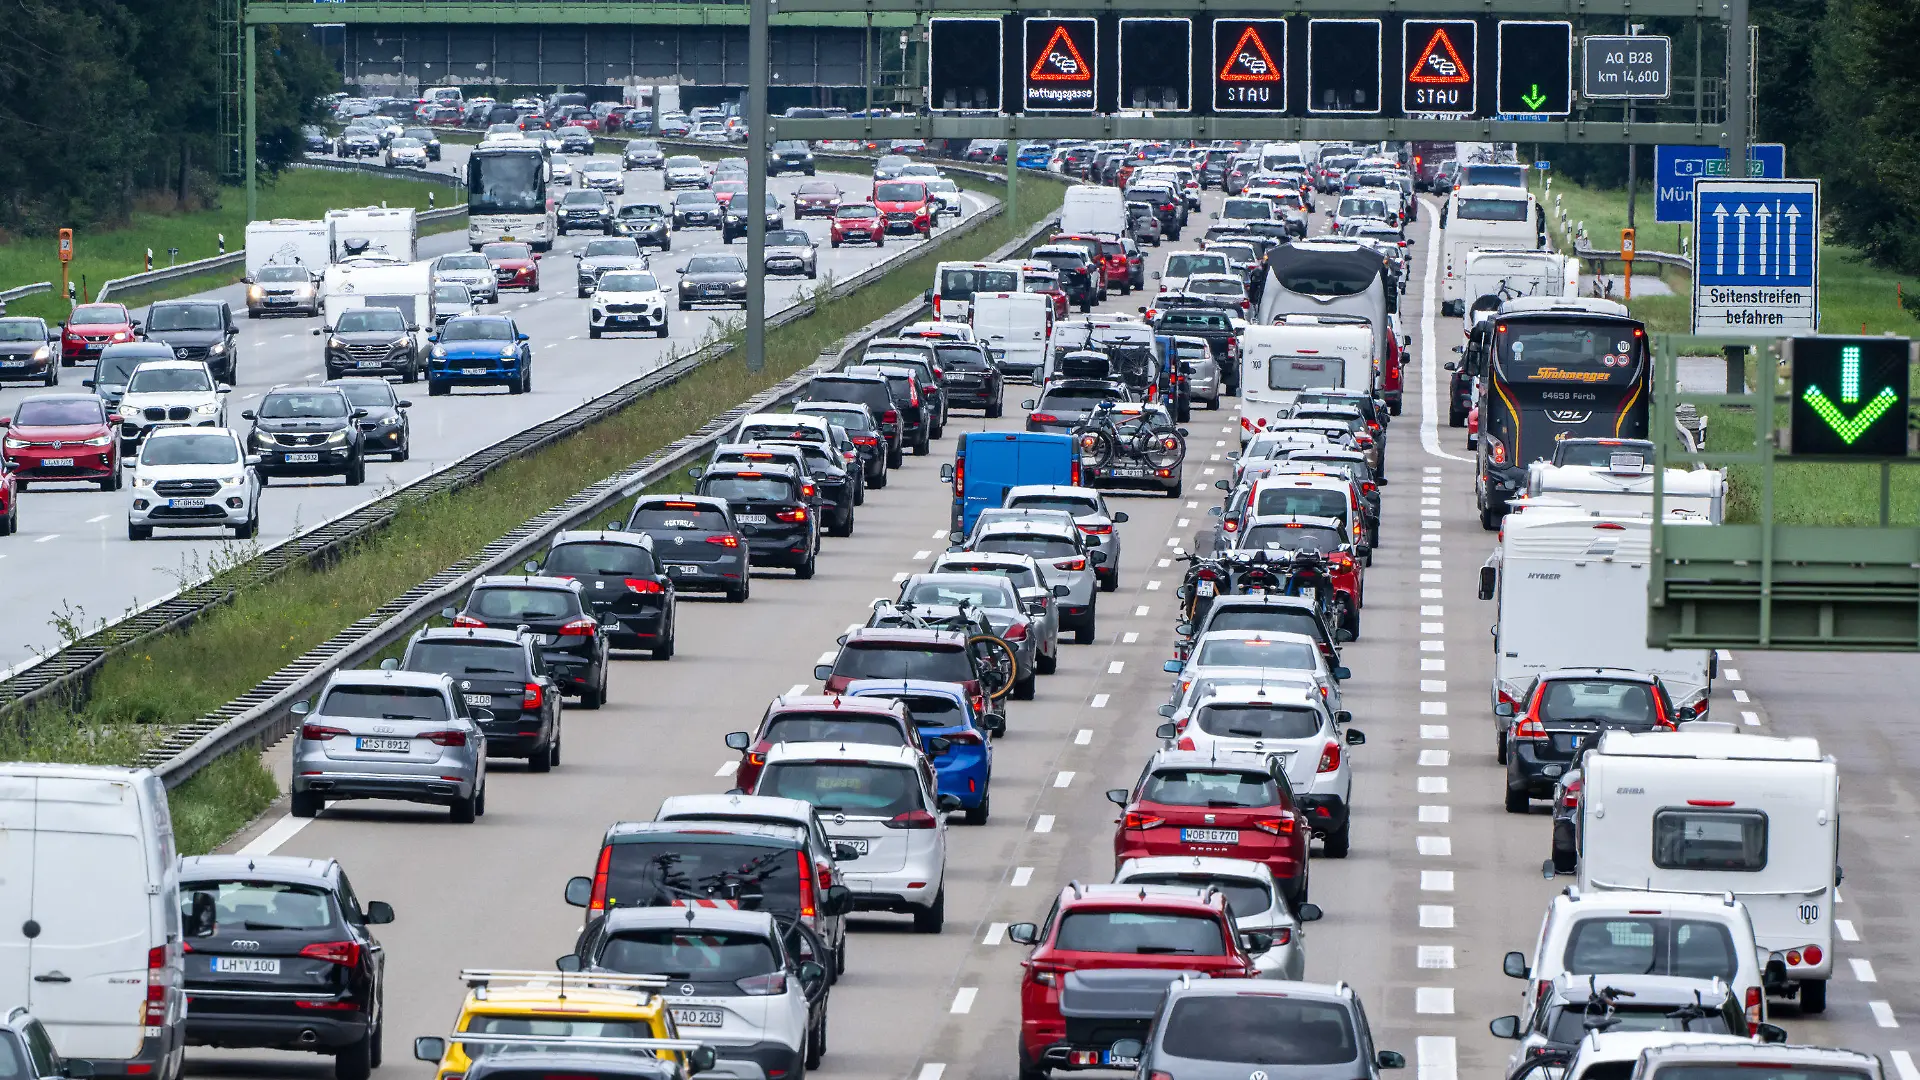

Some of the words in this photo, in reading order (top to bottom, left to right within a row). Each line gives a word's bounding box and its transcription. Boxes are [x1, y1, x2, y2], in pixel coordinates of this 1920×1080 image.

[1605, 52, 1624, 65] AQ
[1629, 52, 1653, 64] B28
[1598, 70, 1618, 83] km
[1622, 70, 1660, 84] 14,600
[1028, 87, 1092, 101] Rettungsgasse
[1228, 87, 1269, 101] STAU
[1417, 89, 1458, 104] STAU
[1685, 162, 1693, 173] 8
[1710, 288, 1801, 304] Seitenstreifen
[1726, 310, 1783, 325] befahren
[1542, 392, 1570, 400] 64658
[1573, 392, 1596, 400] Fürth
[1553, 410, 1585, 419] VDL
[1528, 572, 1561, 580] HYMER
[474, 695, 491, 704] 108
[362, 740, 369, 748] M
[374, 740, 385, 749] ST
[387, 740, 409, 750] 8912
[1186, 829, 1205, 840] WOB
[1211, 830, 1218, 840] G
[1219, 831, 1237, 841] 770
[1798, 905, 1818, 920] 100
[221, 959, 237, 970] LH
[244, 960, 252, 971] V
[254, 960, 275, 972] 100
[699, 1011, 721, 1023] 203
